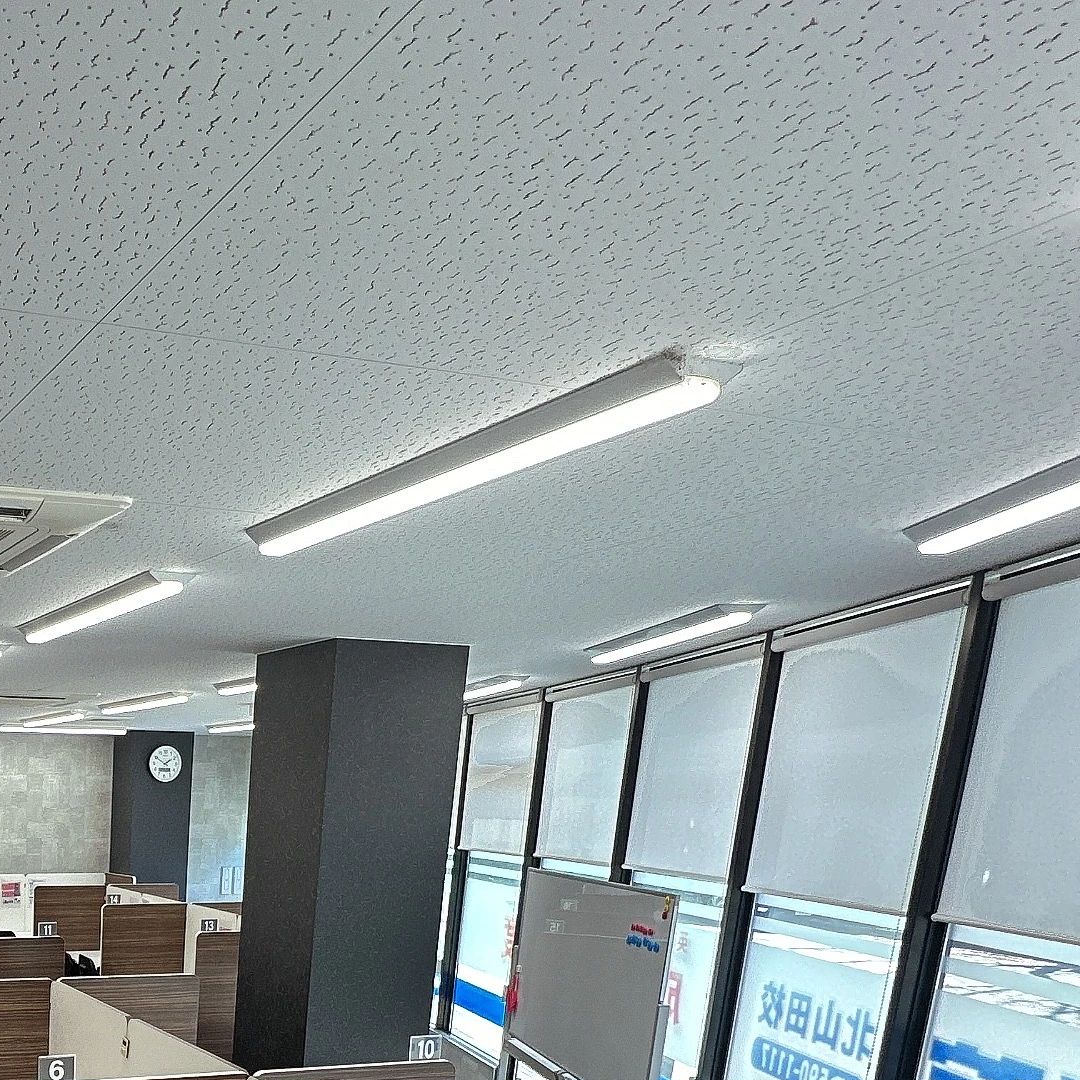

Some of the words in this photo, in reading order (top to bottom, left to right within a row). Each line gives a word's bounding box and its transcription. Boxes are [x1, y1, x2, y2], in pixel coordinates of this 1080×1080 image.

[109, 895, 118, 904] 14
[43, 924, 52, 936] 11
[204, 920, 214, 931] 13
[417, 1039, 435, 1060] 10
[48, 1059, 65, 1080] 6
